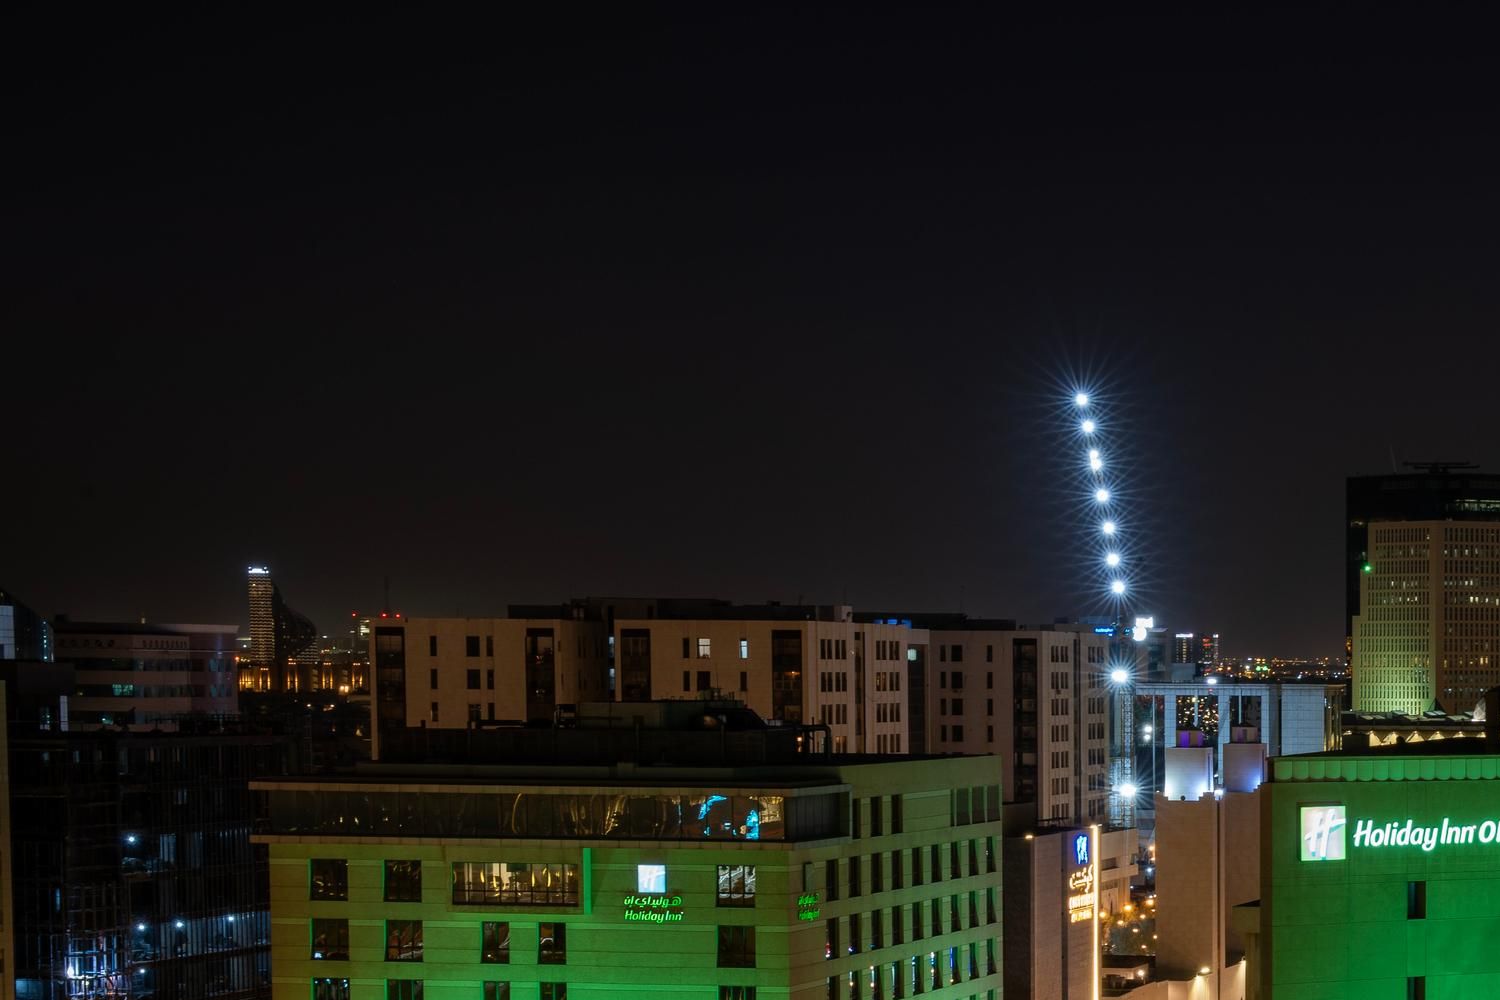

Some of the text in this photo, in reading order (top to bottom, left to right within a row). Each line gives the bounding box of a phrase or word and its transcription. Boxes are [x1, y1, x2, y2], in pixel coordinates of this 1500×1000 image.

[1353, 818, 1438, 851] Holiday
[1440, 817, 1475, 845] Inn
[635, 895, 682, 908] هوليداي
[624, 910, 682, 923] Holiday Inn
